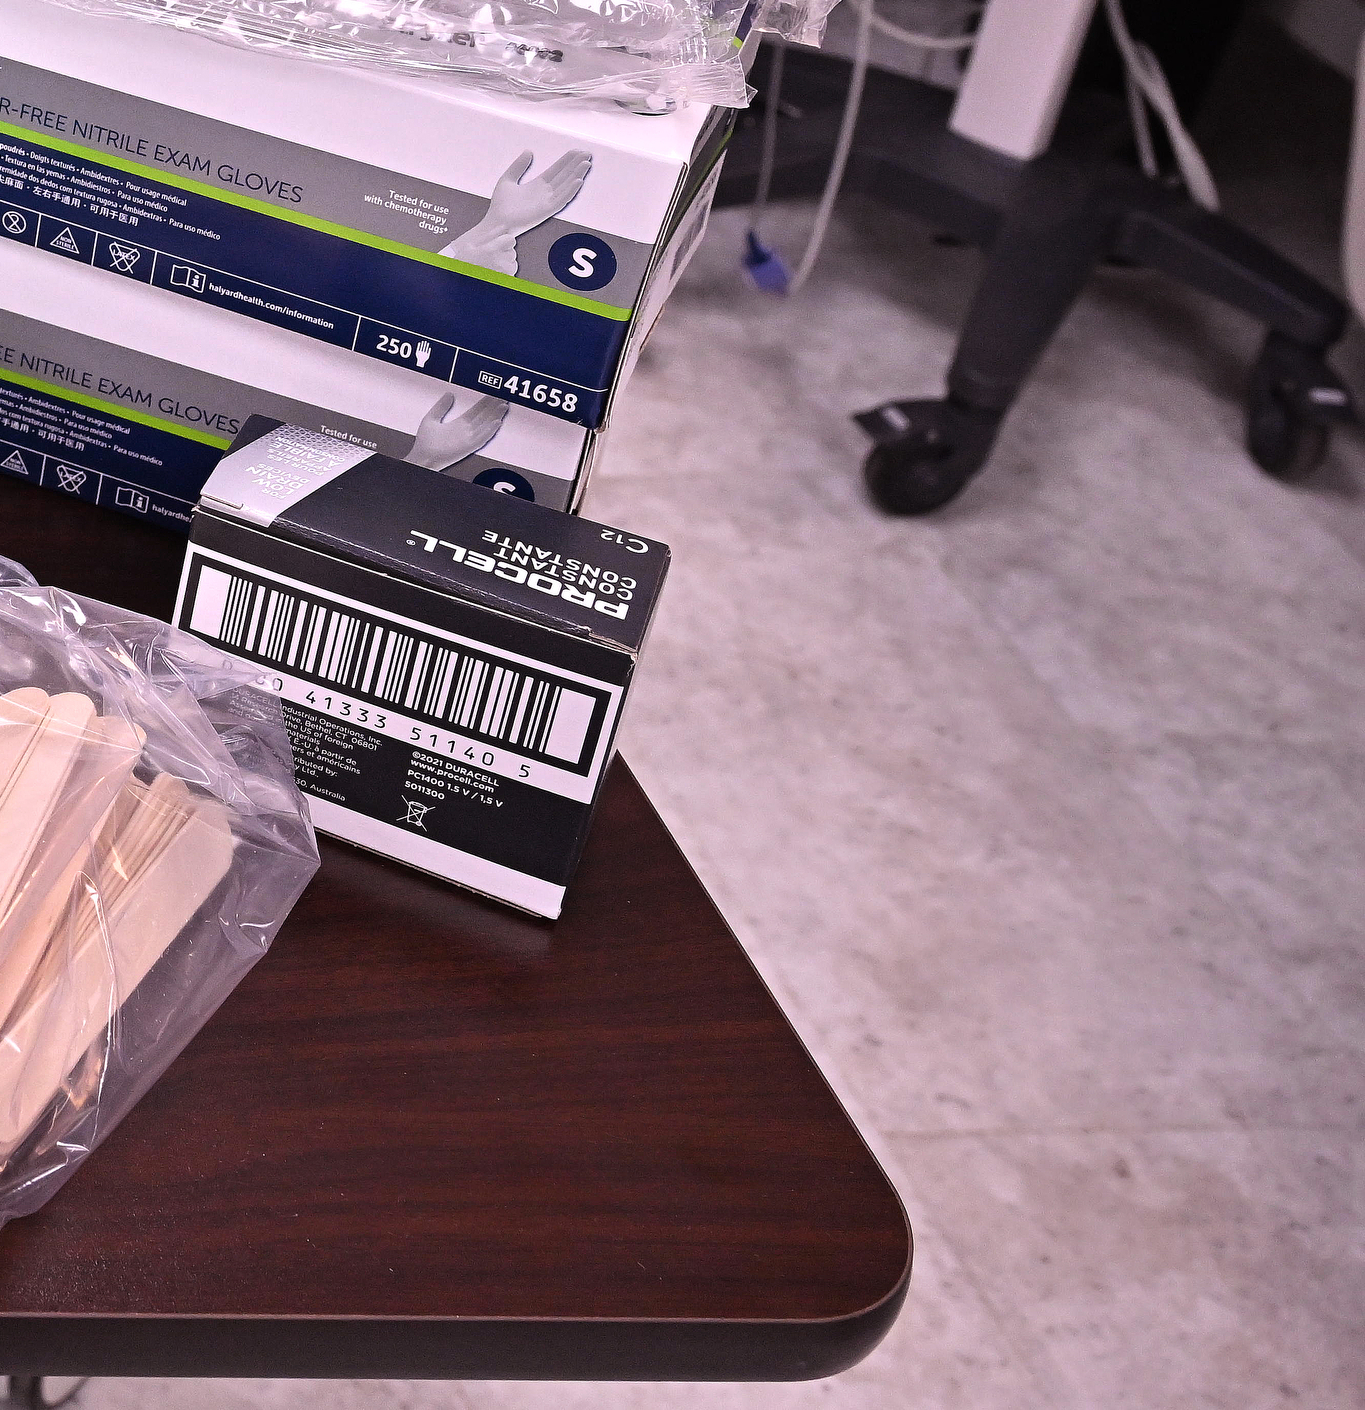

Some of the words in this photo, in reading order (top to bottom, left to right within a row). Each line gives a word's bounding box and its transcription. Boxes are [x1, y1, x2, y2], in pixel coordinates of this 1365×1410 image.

[73, 118, 147, 156] NITRILE
[154, 144, 211, 175] EXAM
[217, 164, 303, 204] GLOVES
[365, 194, 383, 206] with
[385, 200, 447, 225] chemotherapy
[389, 190, 417, 206] Tested
[419, 200, 433, 210] for
[433, 206, 449, 214] use
[569, 247, 597, 278] S
[209, 281, 334, 330] halyardhealth.com/information
[376, 335, 412, 359] 250
[20, 352, 91, 389] NITRILE
[99, 378, 153, 408] EXAM
[159, 397, 239, 434] GLOVES
[481, 372, 500, 387] REF
[504, 374, 577, 412] 41658
[599, 528, 649, 553] C12
[410, 530, 631, 621] PROCELL
[482, 530, 637, 591] CONSTANTE
[493, 546, 633, 602] CONSTANT
[305, 690, 387, 730] 41333
[410, 727, 495, 766] 51140
[519, 764, 531, 780] 5
[325, 736, 353, 750] foreign
[335, 732, 347, 740] CT
[351, 737, 377, 751] 06801
[405, 780, 445, 800] 5011300
[407, 769, 444, 788] PC1400
[447, 782, 460, 792] 1.5
[461, 786, 470, 796] V
[494, 800, 503, 808] V
[410, 760, 495, 793] www.procell.com
[445, 762, 500, 787] DURACELL
[310, 784, 345, 802] Australia
